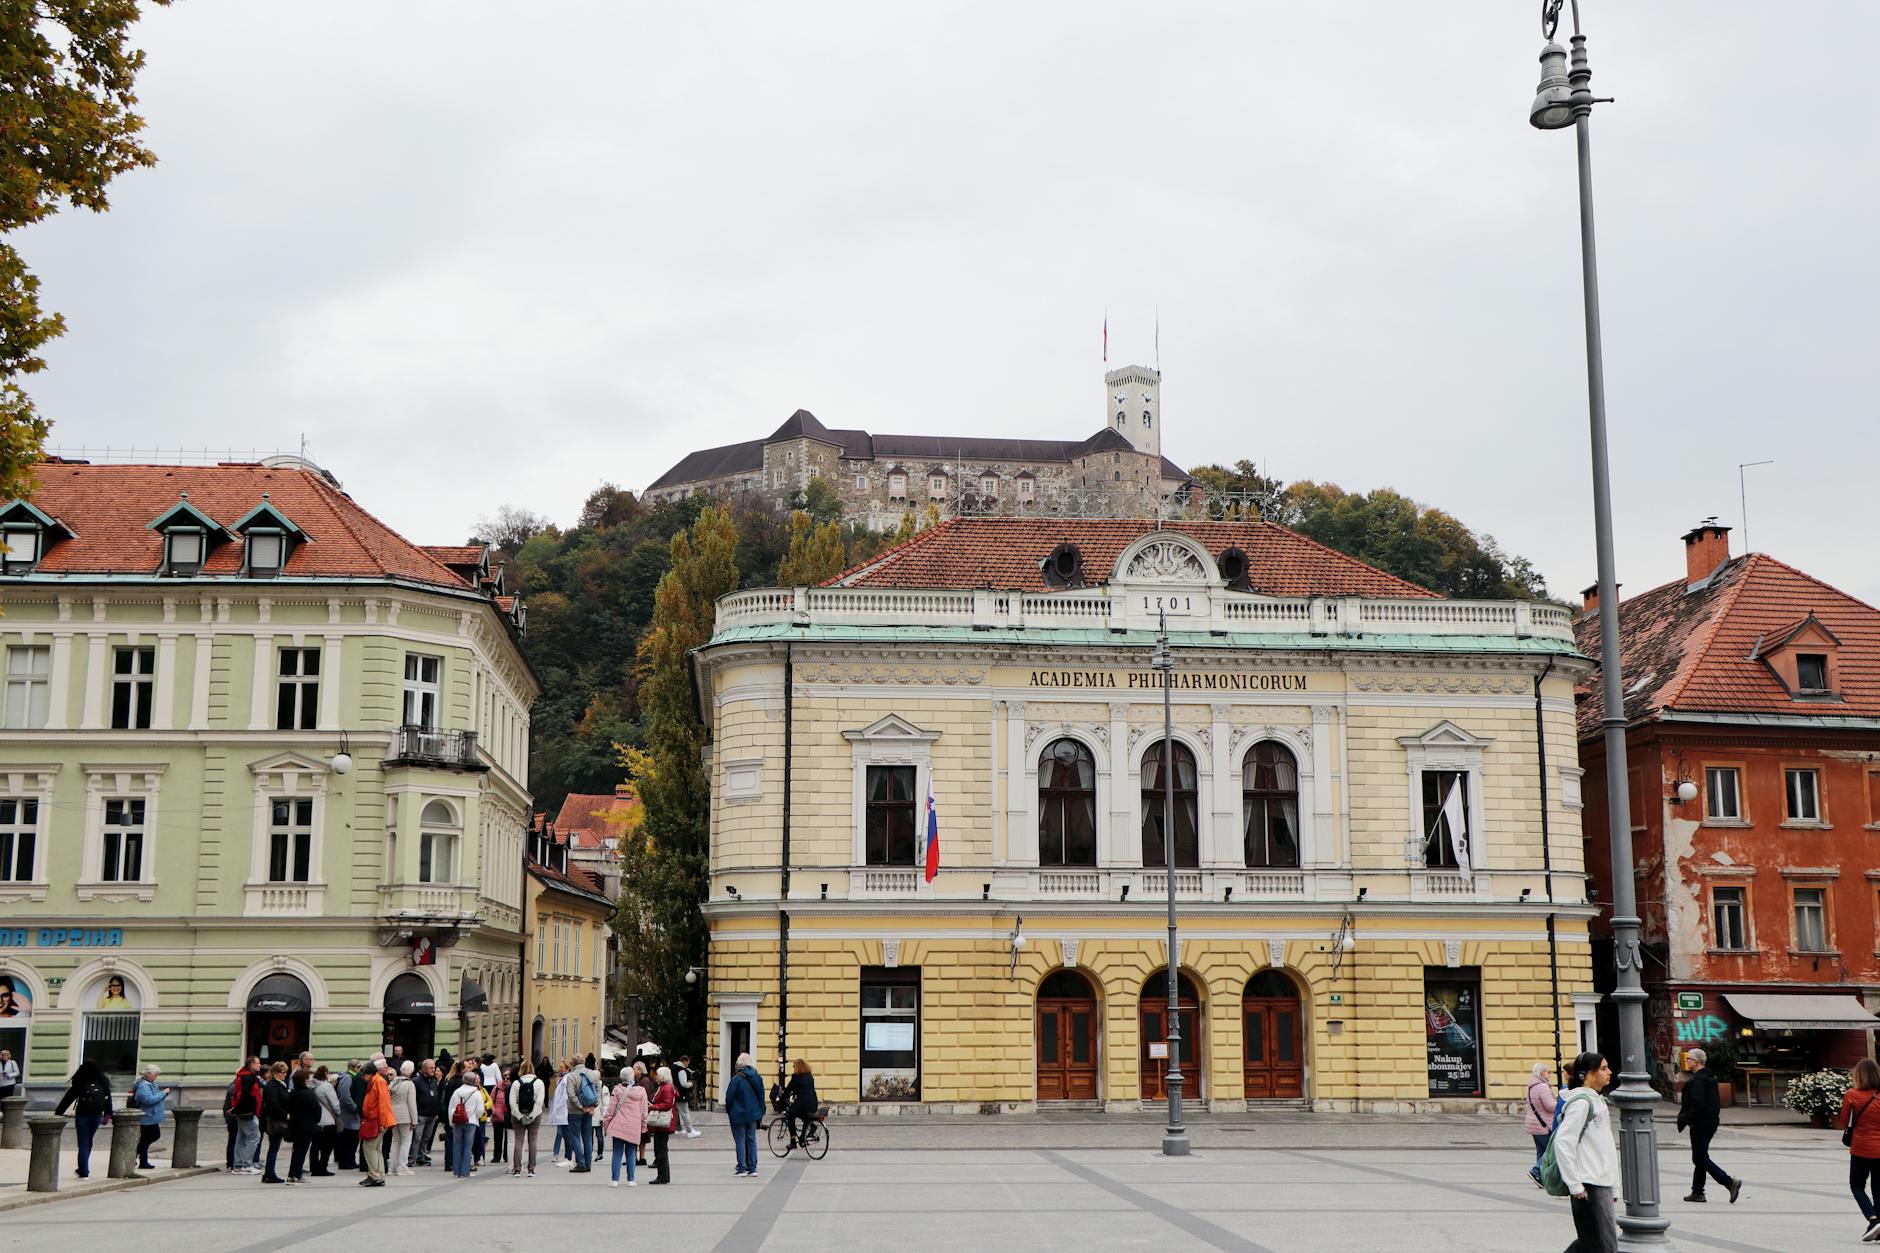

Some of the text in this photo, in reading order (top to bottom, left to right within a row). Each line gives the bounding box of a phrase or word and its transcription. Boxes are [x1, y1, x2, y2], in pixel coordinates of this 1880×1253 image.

[1144, 596, 1190, 610] 1701
[1029, 671, 1307, 690] ACADEMIA PHILHARMONICORUM
[37, 928, 122, 946] OPTIKA
[1433, 1054, 1463, 1064] Nakup
